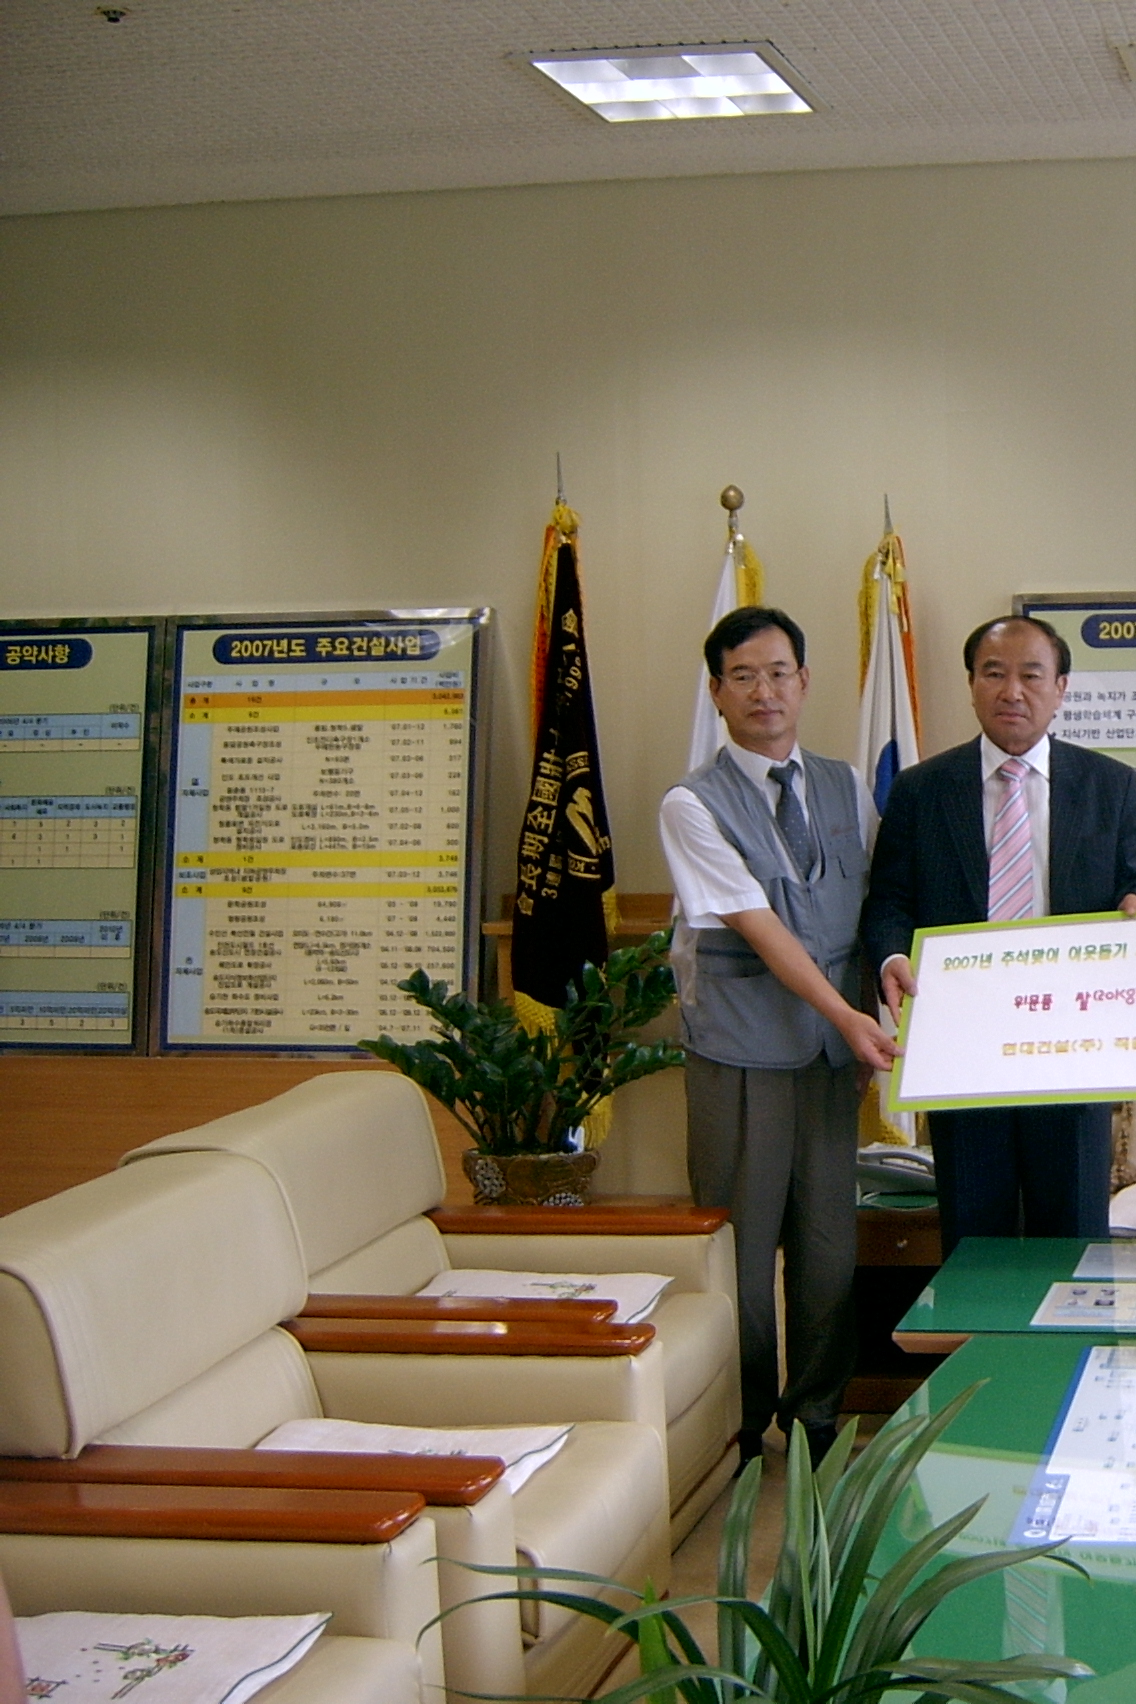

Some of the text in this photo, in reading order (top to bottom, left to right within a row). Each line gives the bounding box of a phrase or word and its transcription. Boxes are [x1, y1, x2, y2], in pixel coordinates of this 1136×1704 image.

[6, 645, 71, 664] 공약사항
[231, 635, 421, 658] 2007년도 주요건설사업
[1098, 690, 1127, 703] 녹지가
[1063, 709, 1122, 721] 평생학습체계
[1062, 727, 1100, 739] 지식기반
[943, 953, 993, 971] 2007년
[1001, 947, 1060, 968] 추석맞이
[1067, 942, 1128, 963] 이웃돕기
[1013, 993, 1053, 1012] 위문품
[1002, 1038, 1104, 1056] 현대건설(주)
